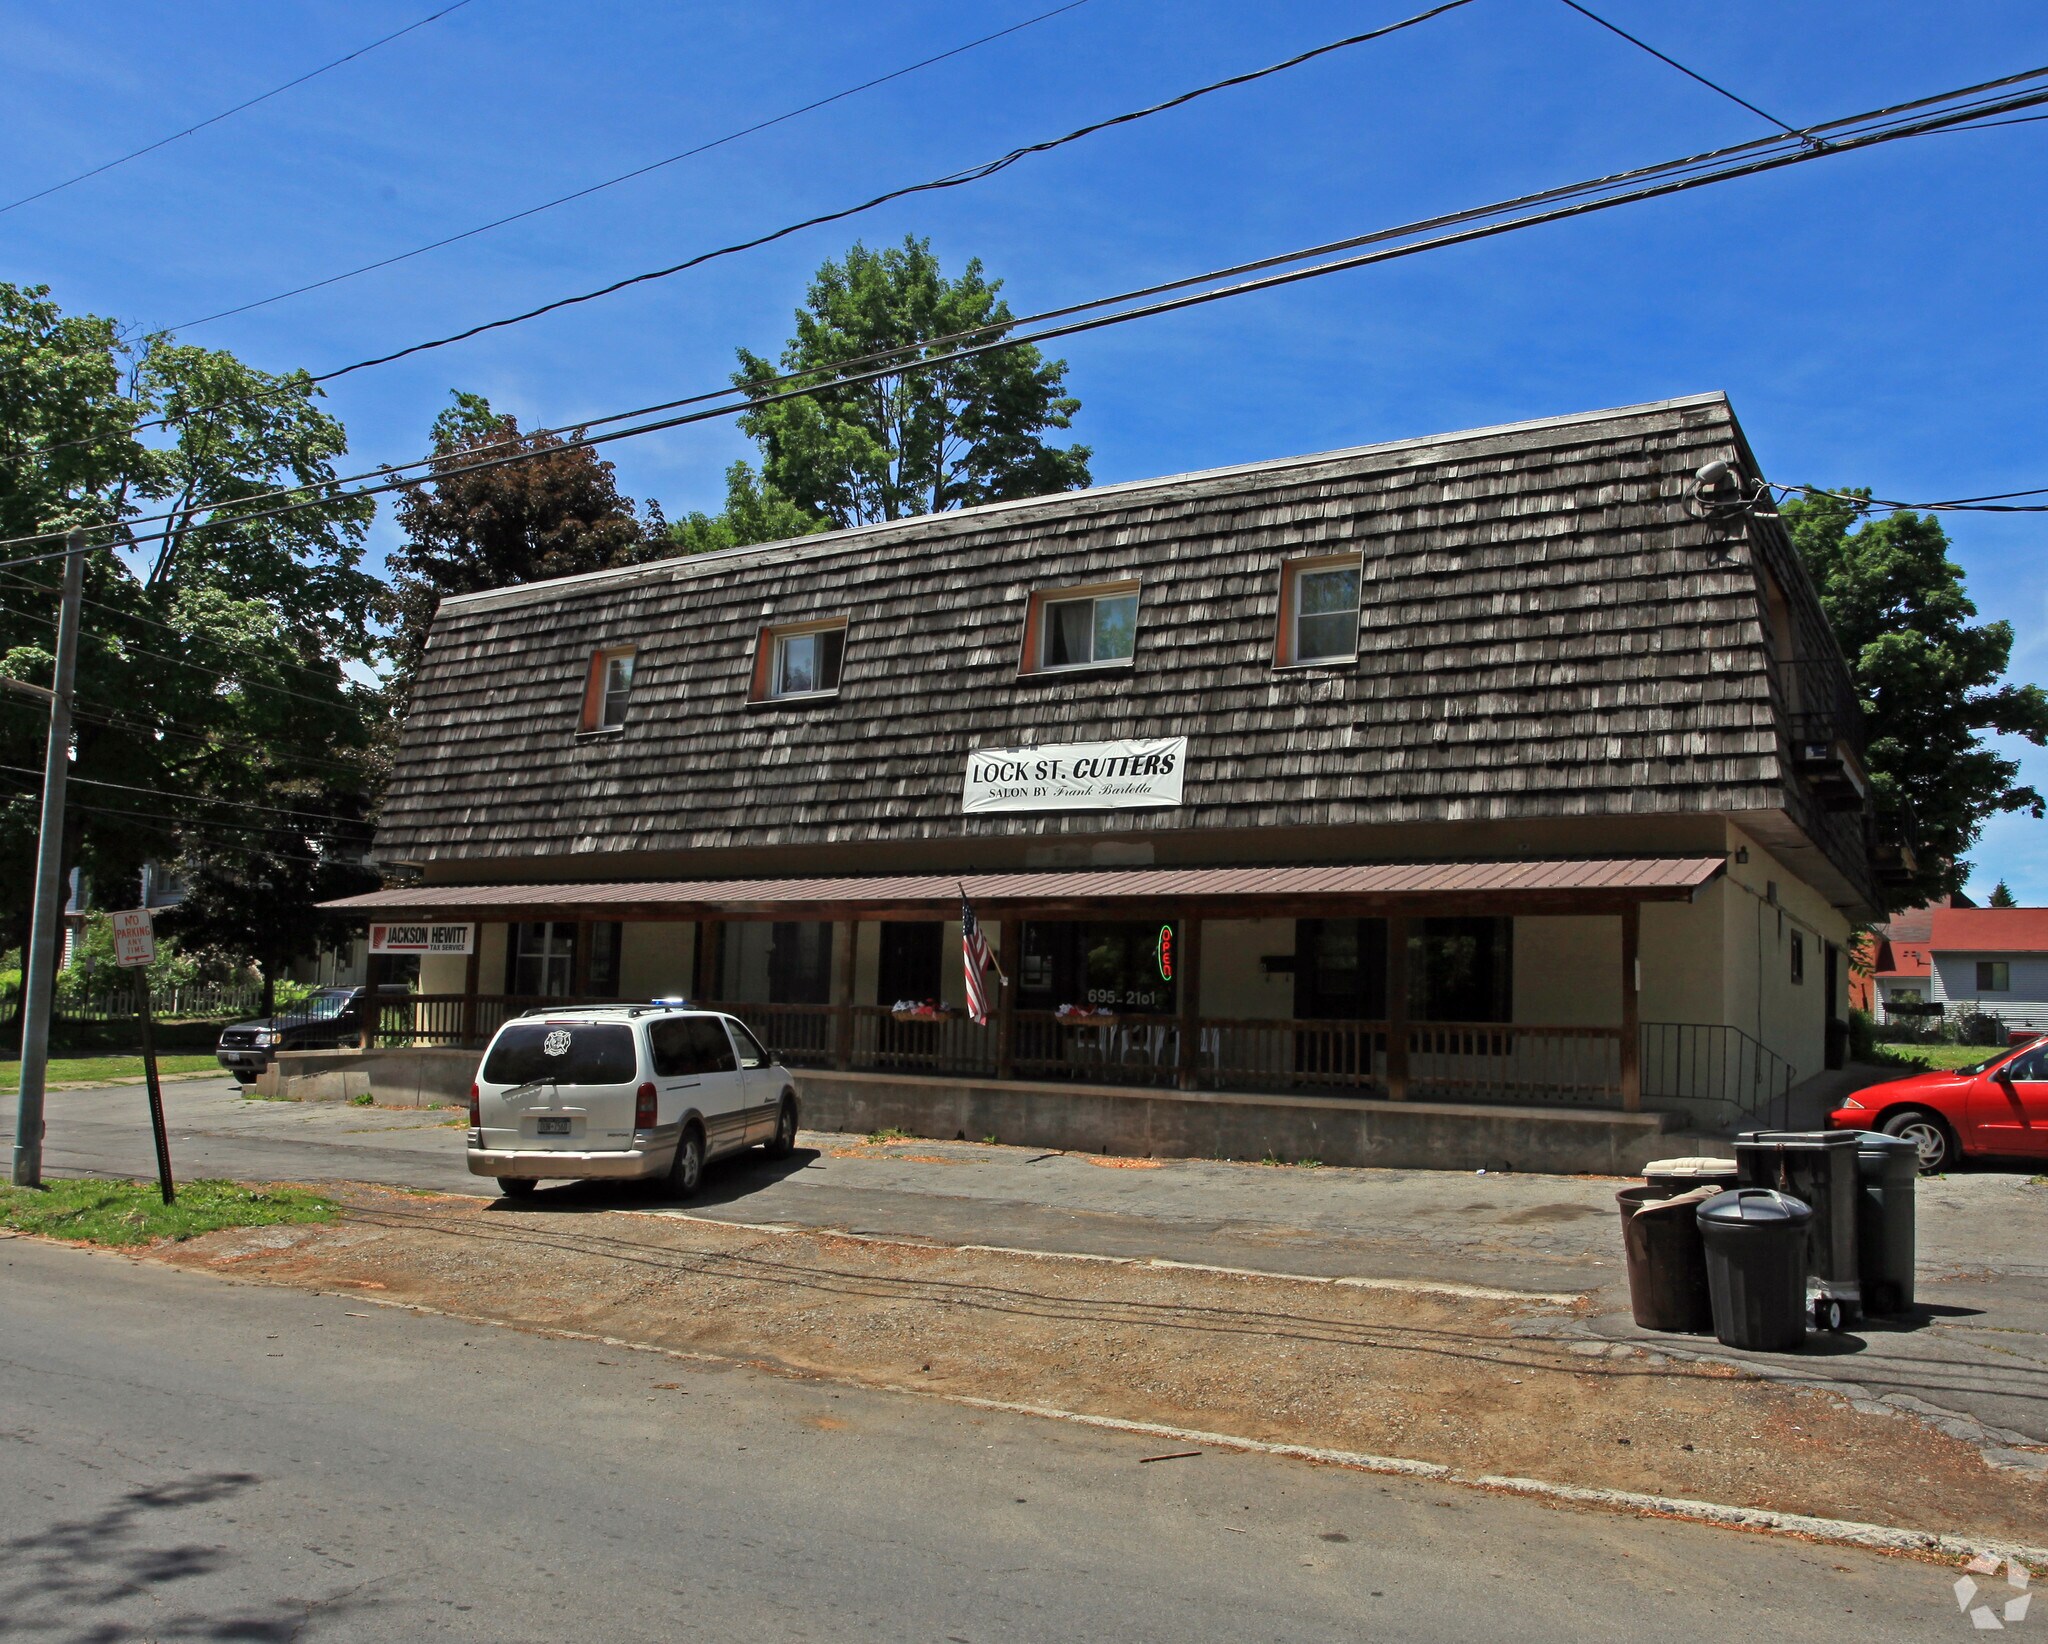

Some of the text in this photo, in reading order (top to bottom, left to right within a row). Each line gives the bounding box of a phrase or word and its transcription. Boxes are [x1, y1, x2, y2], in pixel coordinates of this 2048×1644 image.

[973, 753, 1176, 783] LOCK ST. CUTTERS
[989, 787, 1028, 798] SALON
[1033, 787, 1049, 797] BY
[1053, 785, 1093, 796] Frank
[124, 915, 139, 926] NO
[116, 926, 150, 939] PARKING
[387, 927, 468, 943] JACKSON HEWITT
[127, 946, 145, 954] TIME
[1162, 929, 1172, 976] OPEN
